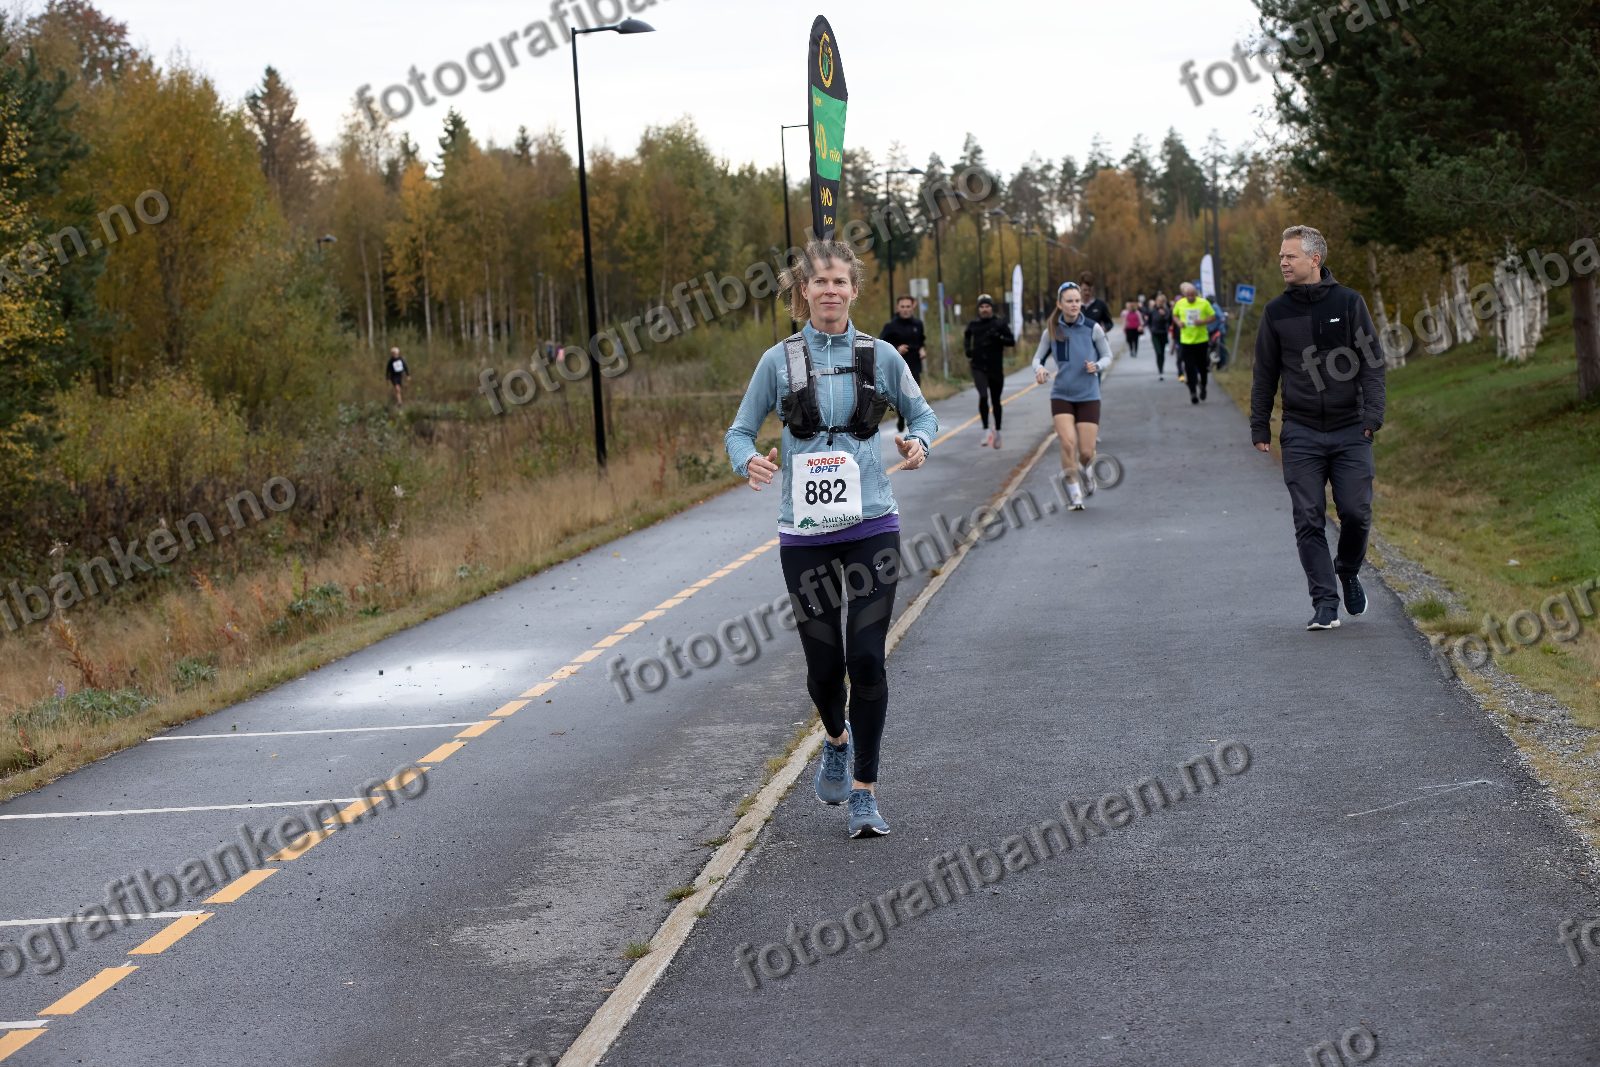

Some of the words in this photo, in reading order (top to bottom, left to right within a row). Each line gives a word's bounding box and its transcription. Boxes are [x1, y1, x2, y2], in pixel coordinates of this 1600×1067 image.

[806, 456, 847, 467] NORGES
[810, 464, 841, 474] LØPET
[805, 478, 848, 505] 882
